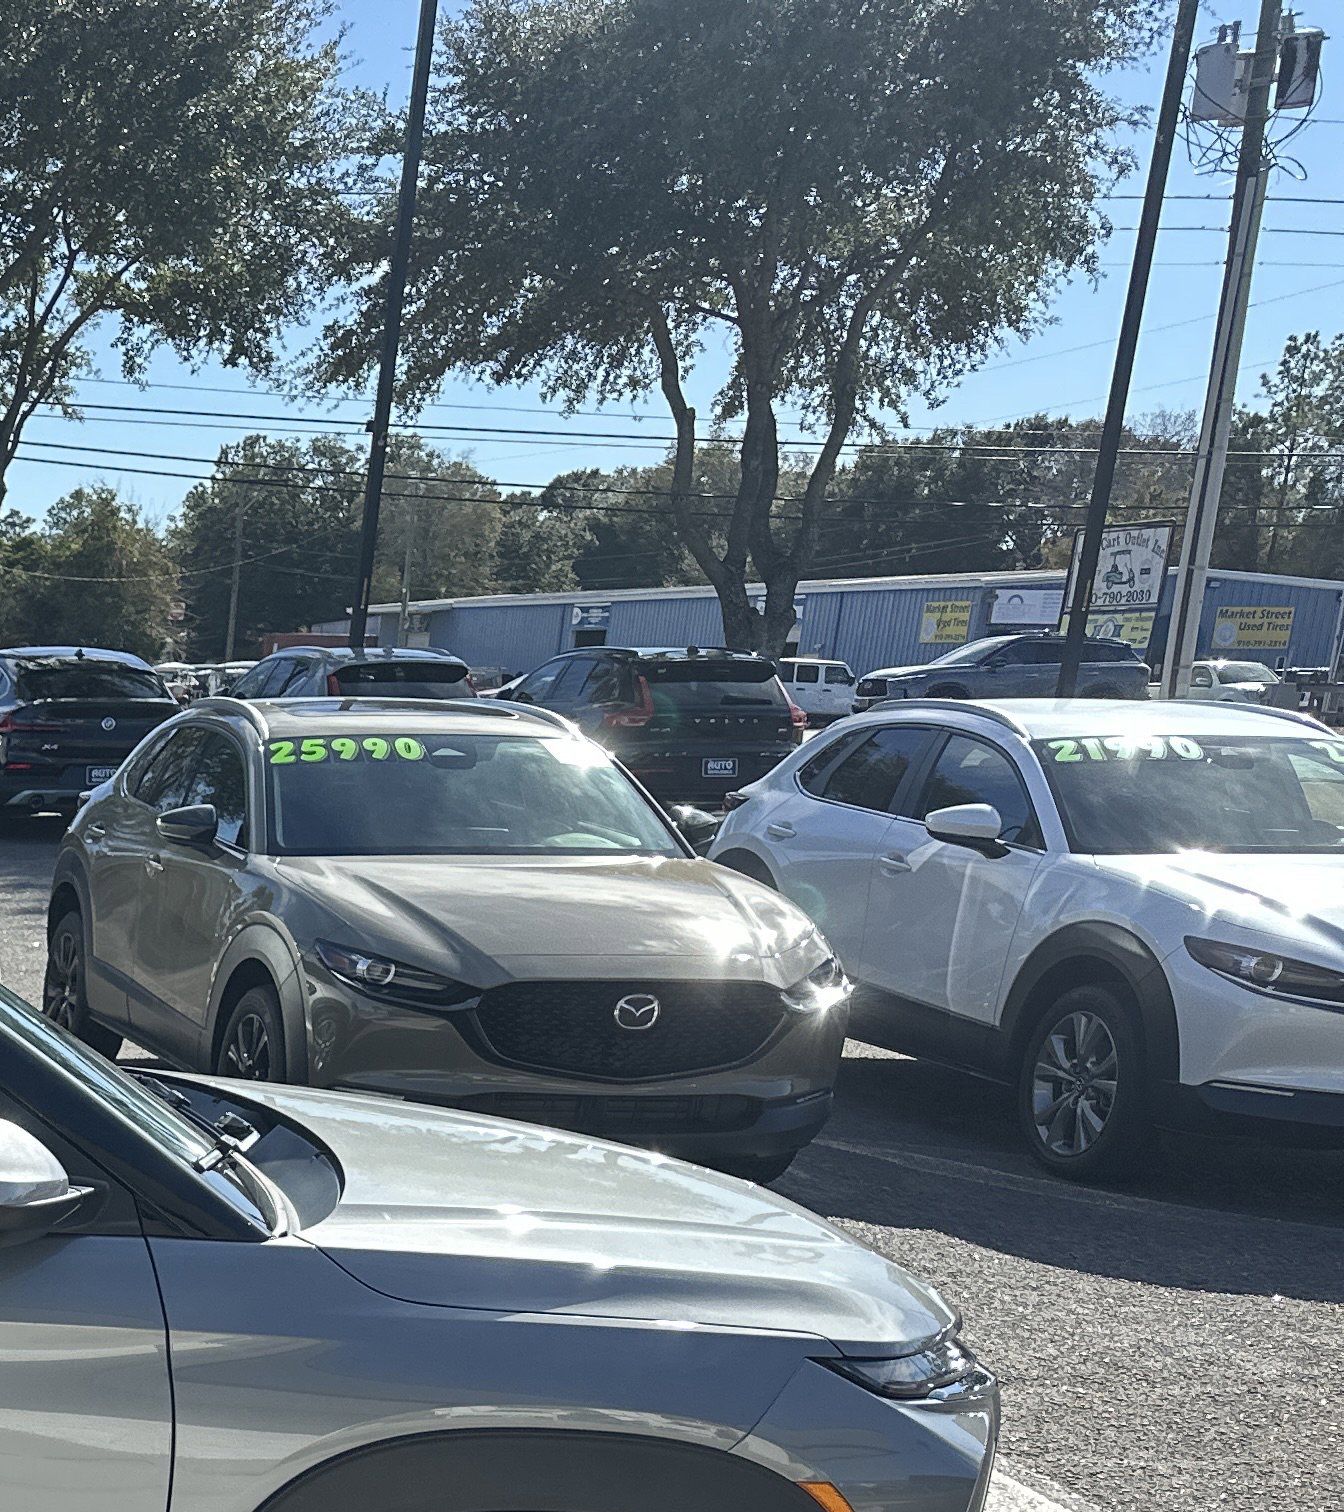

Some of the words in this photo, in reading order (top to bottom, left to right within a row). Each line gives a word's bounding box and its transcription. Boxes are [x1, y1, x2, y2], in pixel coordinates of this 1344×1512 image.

[1090, 589, 1152, 605] 0-790-2030
[1217, 608, 1257, 620] Market
[1258, 608, 1293, 620] Street
[1238, 621, 1265, 632] Used
[1266, 621, 1291, 632] Tires
[268, 737, 425, 764] 25990
[707, 760, 733, 770] AUTO
